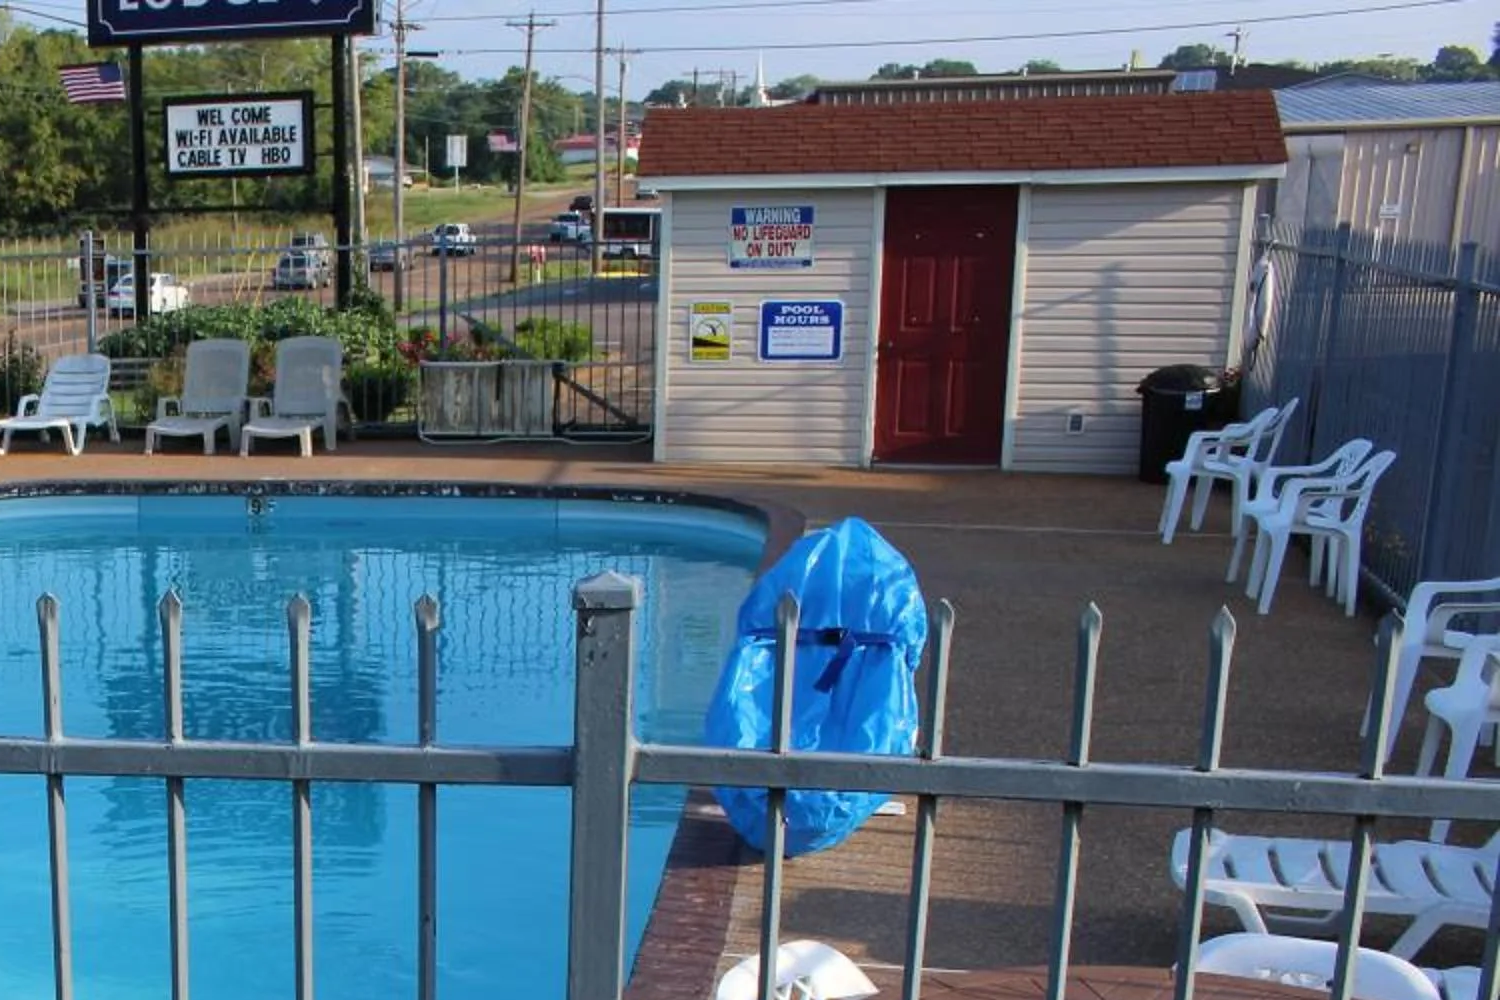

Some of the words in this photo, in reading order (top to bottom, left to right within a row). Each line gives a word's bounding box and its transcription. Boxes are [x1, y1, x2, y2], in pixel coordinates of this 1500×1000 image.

[175, 129, 212, 147] WI-FI
[218, 125, 297, 146] AVAILABLE
[177, 149, 221, 168] CABLE
[228, 148, 247, 166] TV
[261, 147, 291, 165] HBO
[745, 207, 801, 224] WARNING
[733, 226, 748, 241] NO
[753, 225, 811, 241] LIFEGUARD
[747, 243, 762, 257] ON
[768, 242, 797, 256] DUTY
[781, 305, 825, 315] POOL
[773, 315, 831, 325] HOURS
